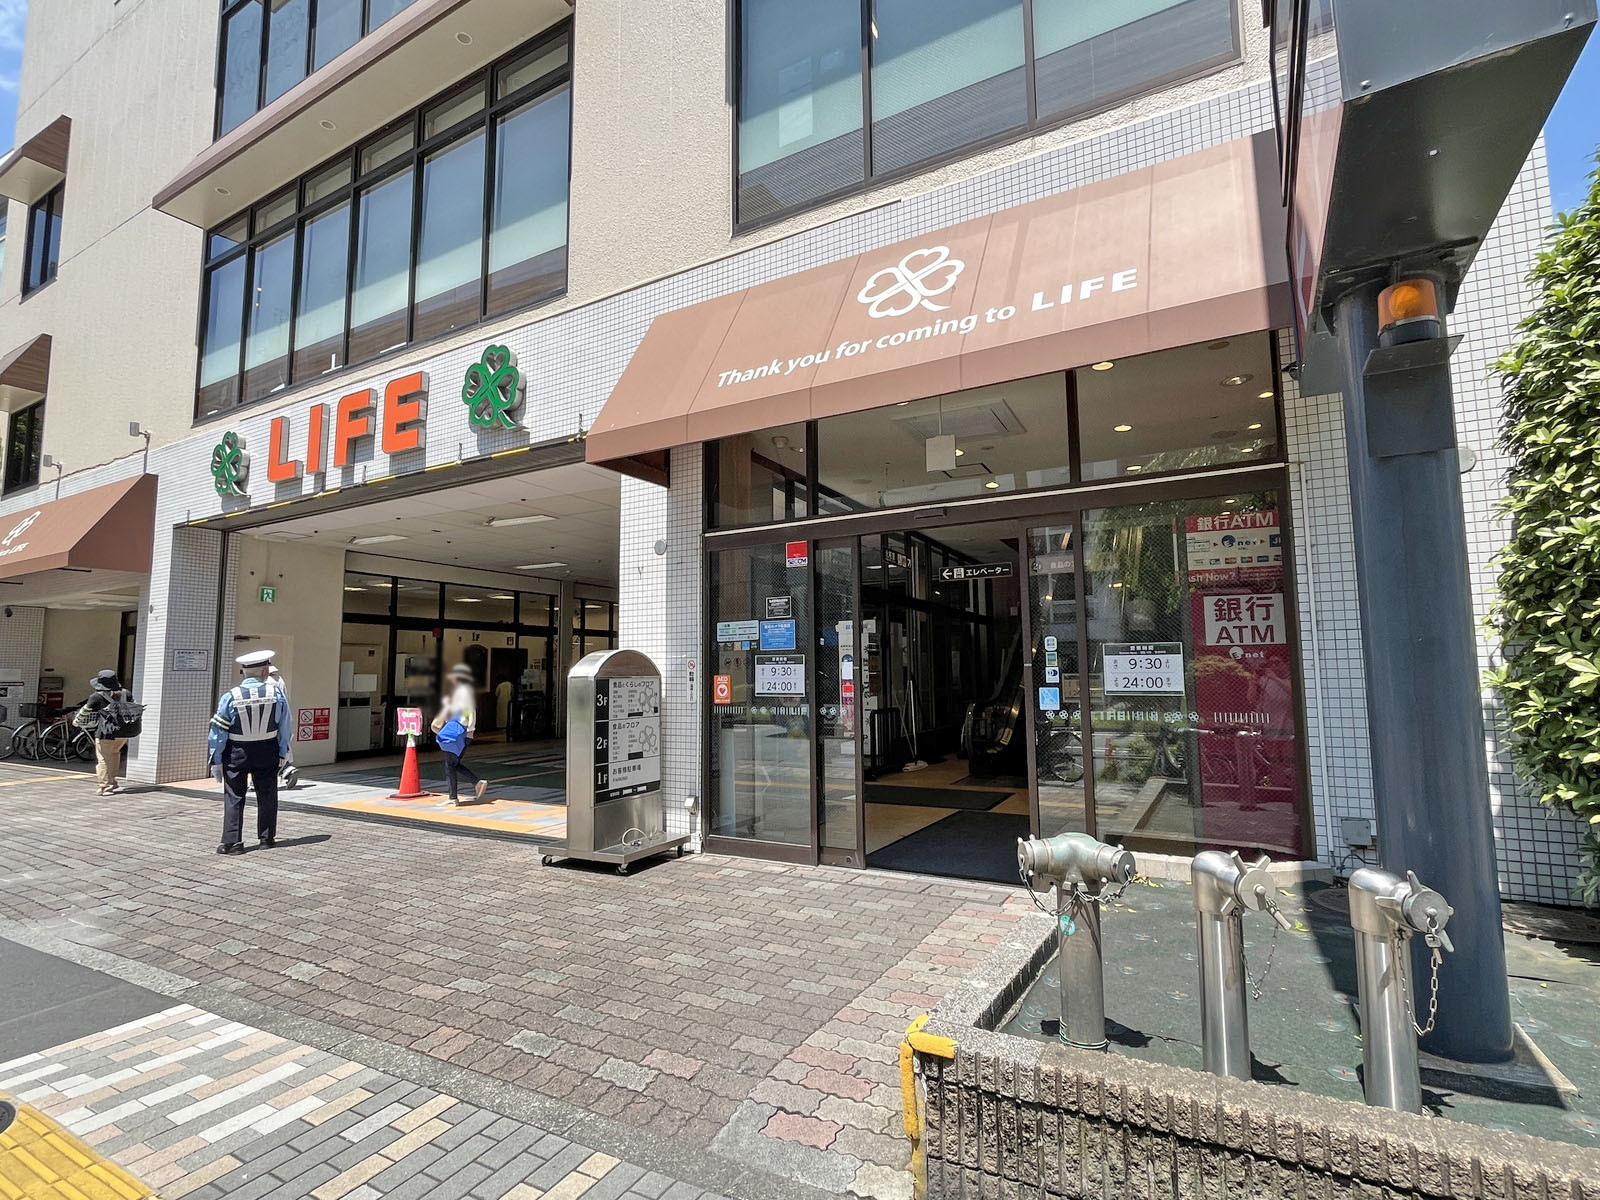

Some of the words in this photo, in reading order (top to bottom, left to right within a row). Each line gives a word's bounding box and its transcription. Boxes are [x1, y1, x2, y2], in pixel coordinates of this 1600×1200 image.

[717, 359, 784, 388] Thank
[784, 350, 831, 375] you
[835, 338, 873, 360] for
[875, 313, 978, 350] coming
[985, 304, 1017, 324] to
[1031, 268, 1138, 312] LIFE
[267, 371, 429, 484] LIFE
[1197, 512, 1274, 531] 銀行ATM
[965, 566, 1010, 577] エレベーター
[1213, 596, 1275, 622] 銀行
[1216, 624, 1275, 644] ATM
[1128, 657, 1162, 670] 9:30
[770, 666, 792, 677] 9:30
[766, 681, 792, 692] 24:00
[1122, 676, 1164, 689] 24:00
[596, 694, 608, 707] 3F
[596, 737, 608, 750] 2F
[597, 773, 608, 785] 1F
